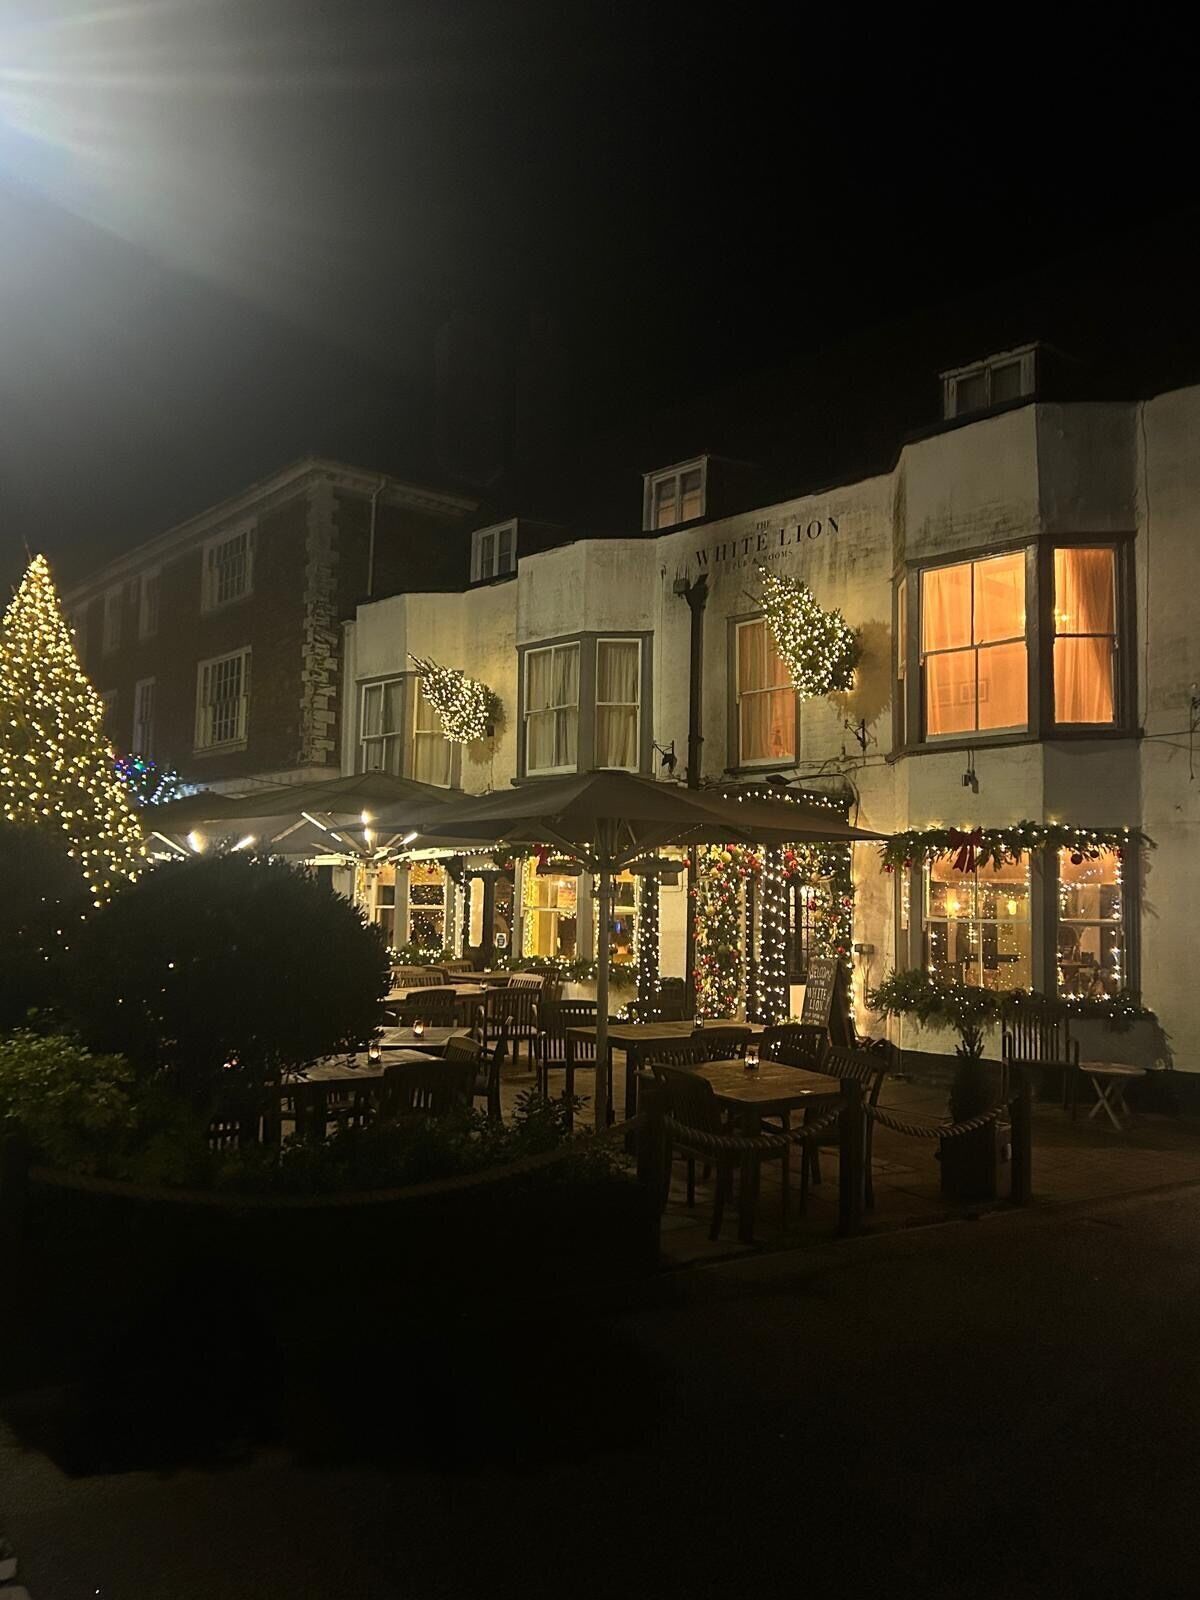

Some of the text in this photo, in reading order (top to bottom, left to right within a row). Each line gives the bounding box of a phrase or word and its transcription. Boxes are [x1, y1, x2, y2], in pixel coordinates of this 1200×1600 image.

[756, 520, 769, 530] THE
[696, 516, 840, 566] WHITE LION
[807, 988, 827, 1000] WHITE
